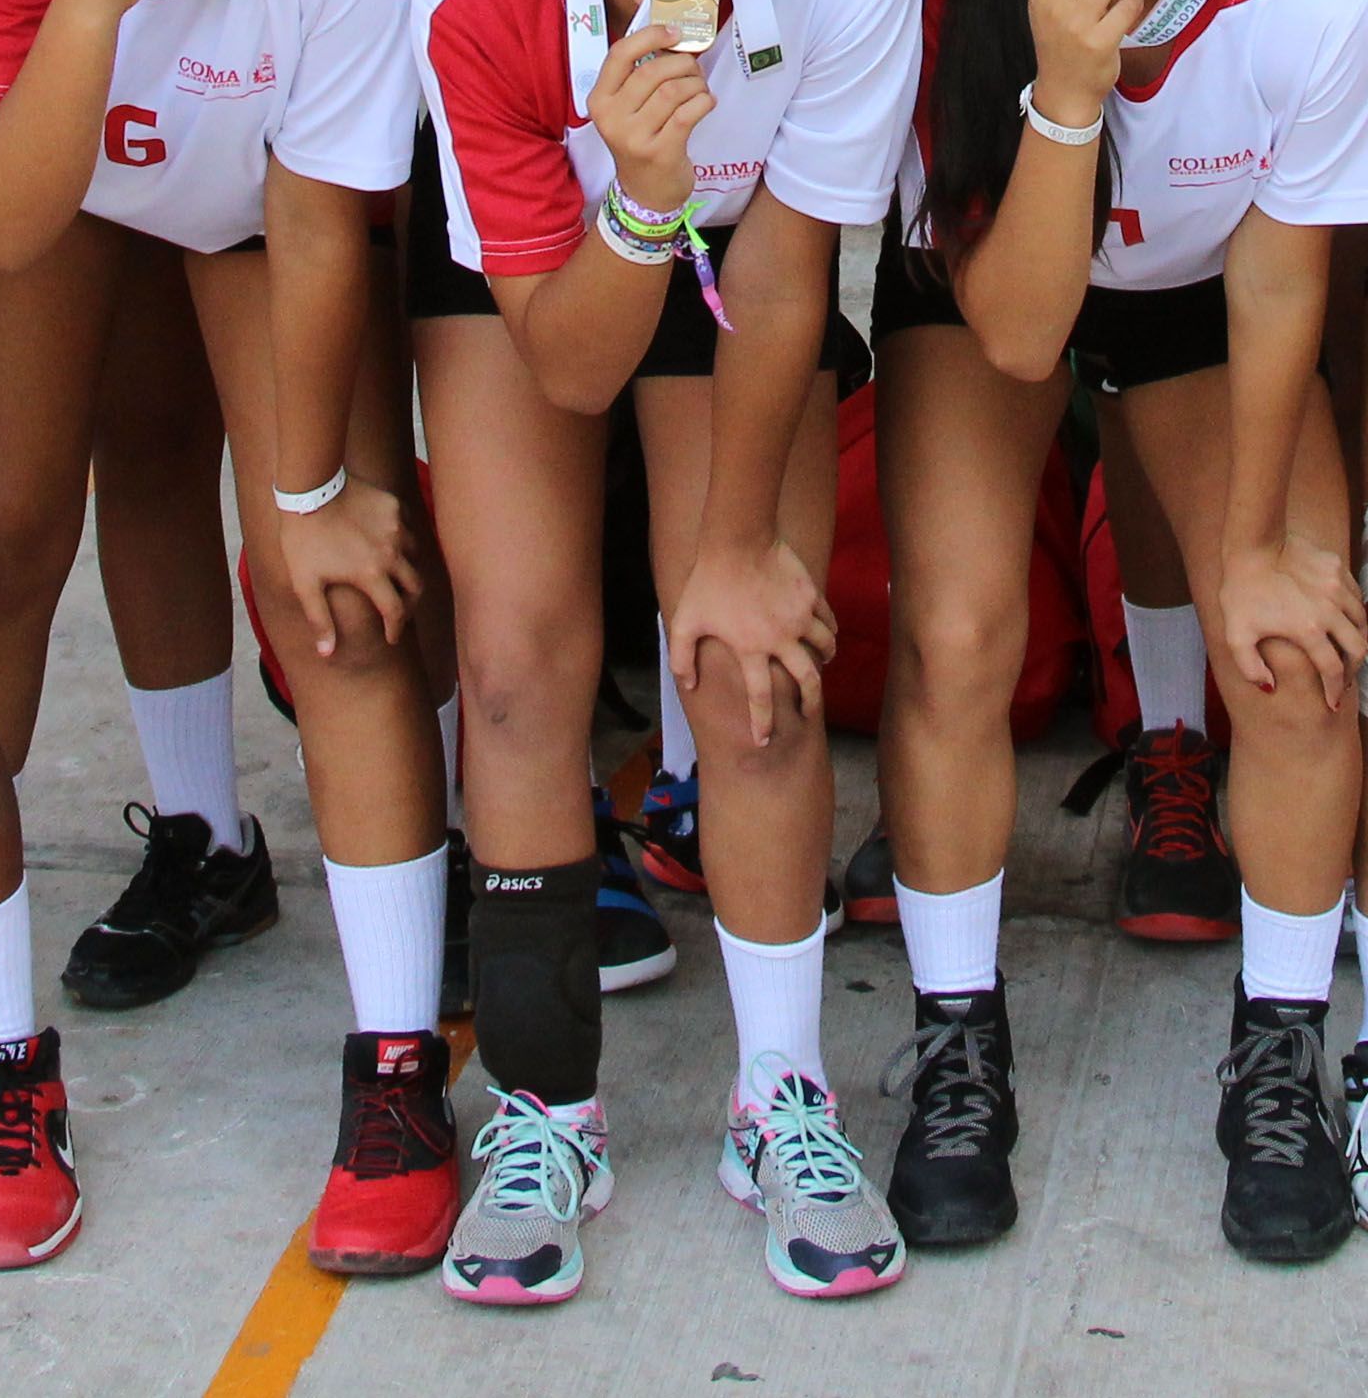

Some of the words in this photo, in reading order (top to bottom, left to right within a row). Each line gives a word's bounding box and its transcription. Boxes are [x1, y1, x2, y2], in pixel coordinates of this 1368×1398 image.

[105, 104, 166, 167] 6
[1168, 148, 1255, 171] COLIMA
[500, 875, 544, 892] asics
